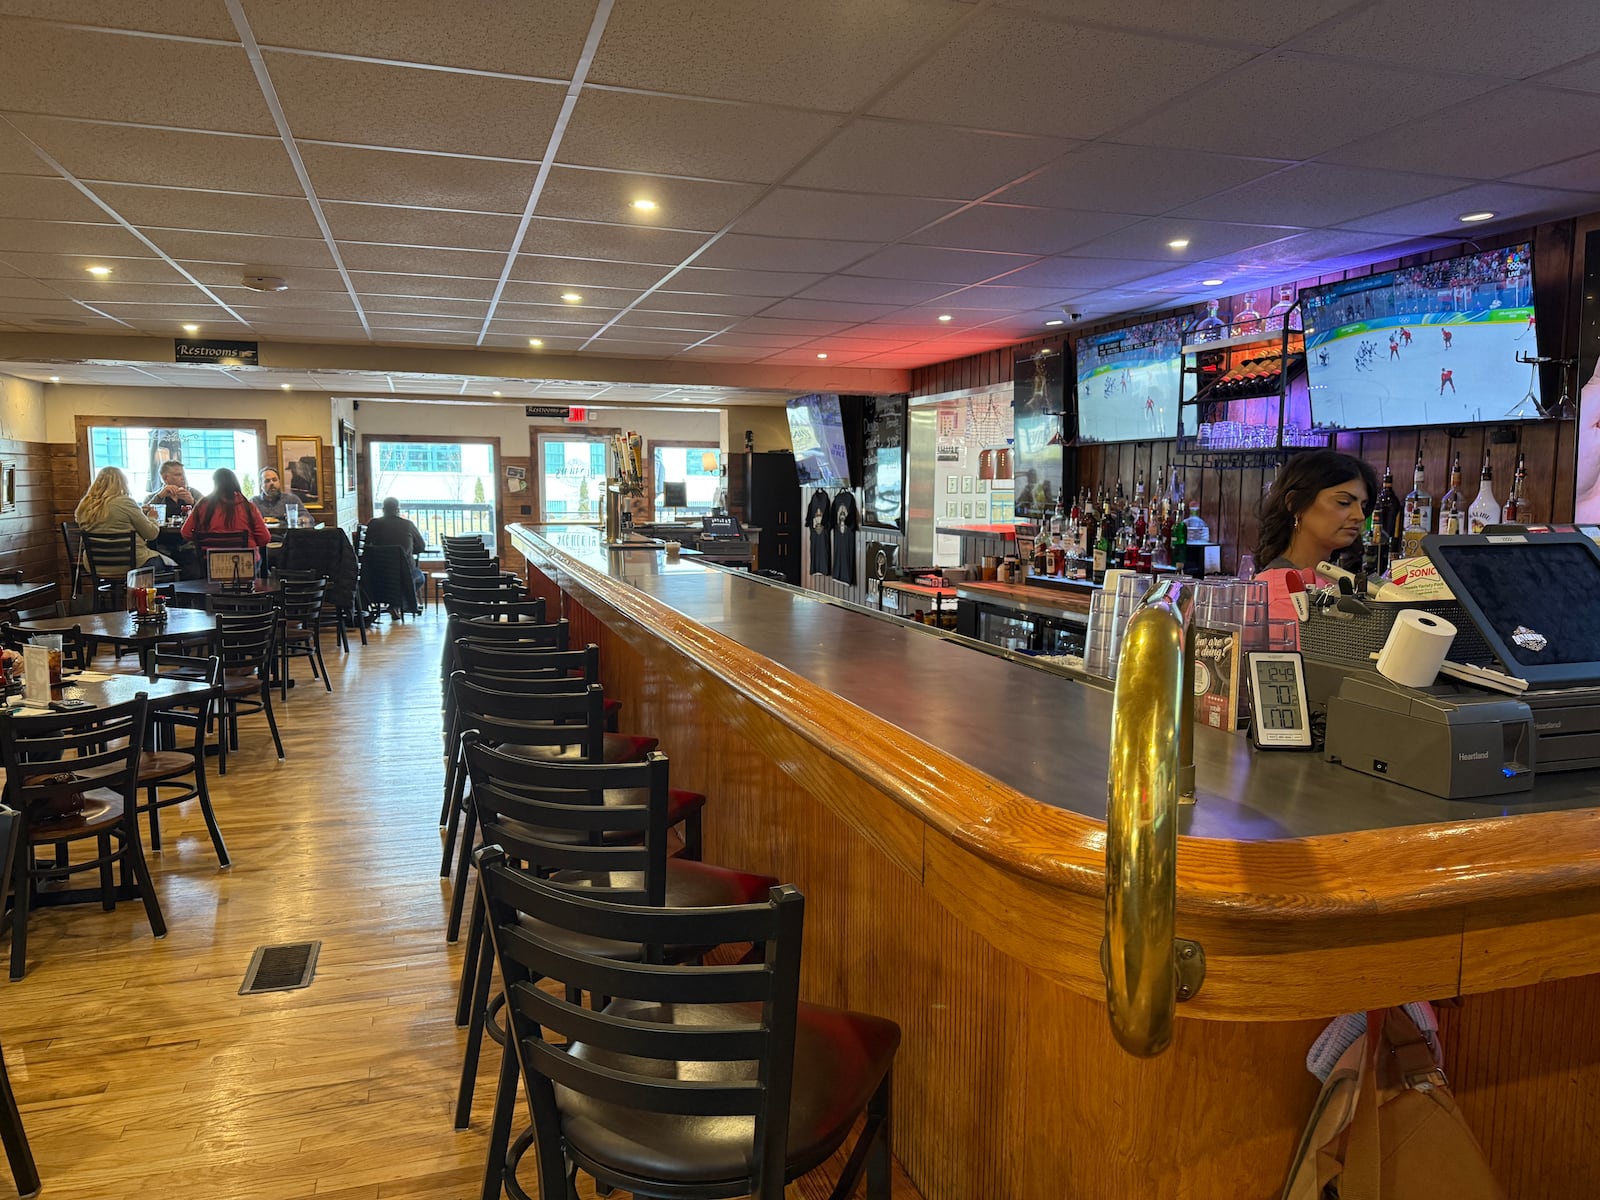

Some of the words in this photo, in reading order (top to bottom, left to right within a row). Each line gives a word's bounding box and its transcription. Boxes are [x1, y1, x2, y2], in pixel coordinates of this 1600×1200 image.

[177, 344, 238, 357] Restrooms
[1408, 567, 1437, 578] SONIC
[1458, 751, 1489, 761] Heartland
